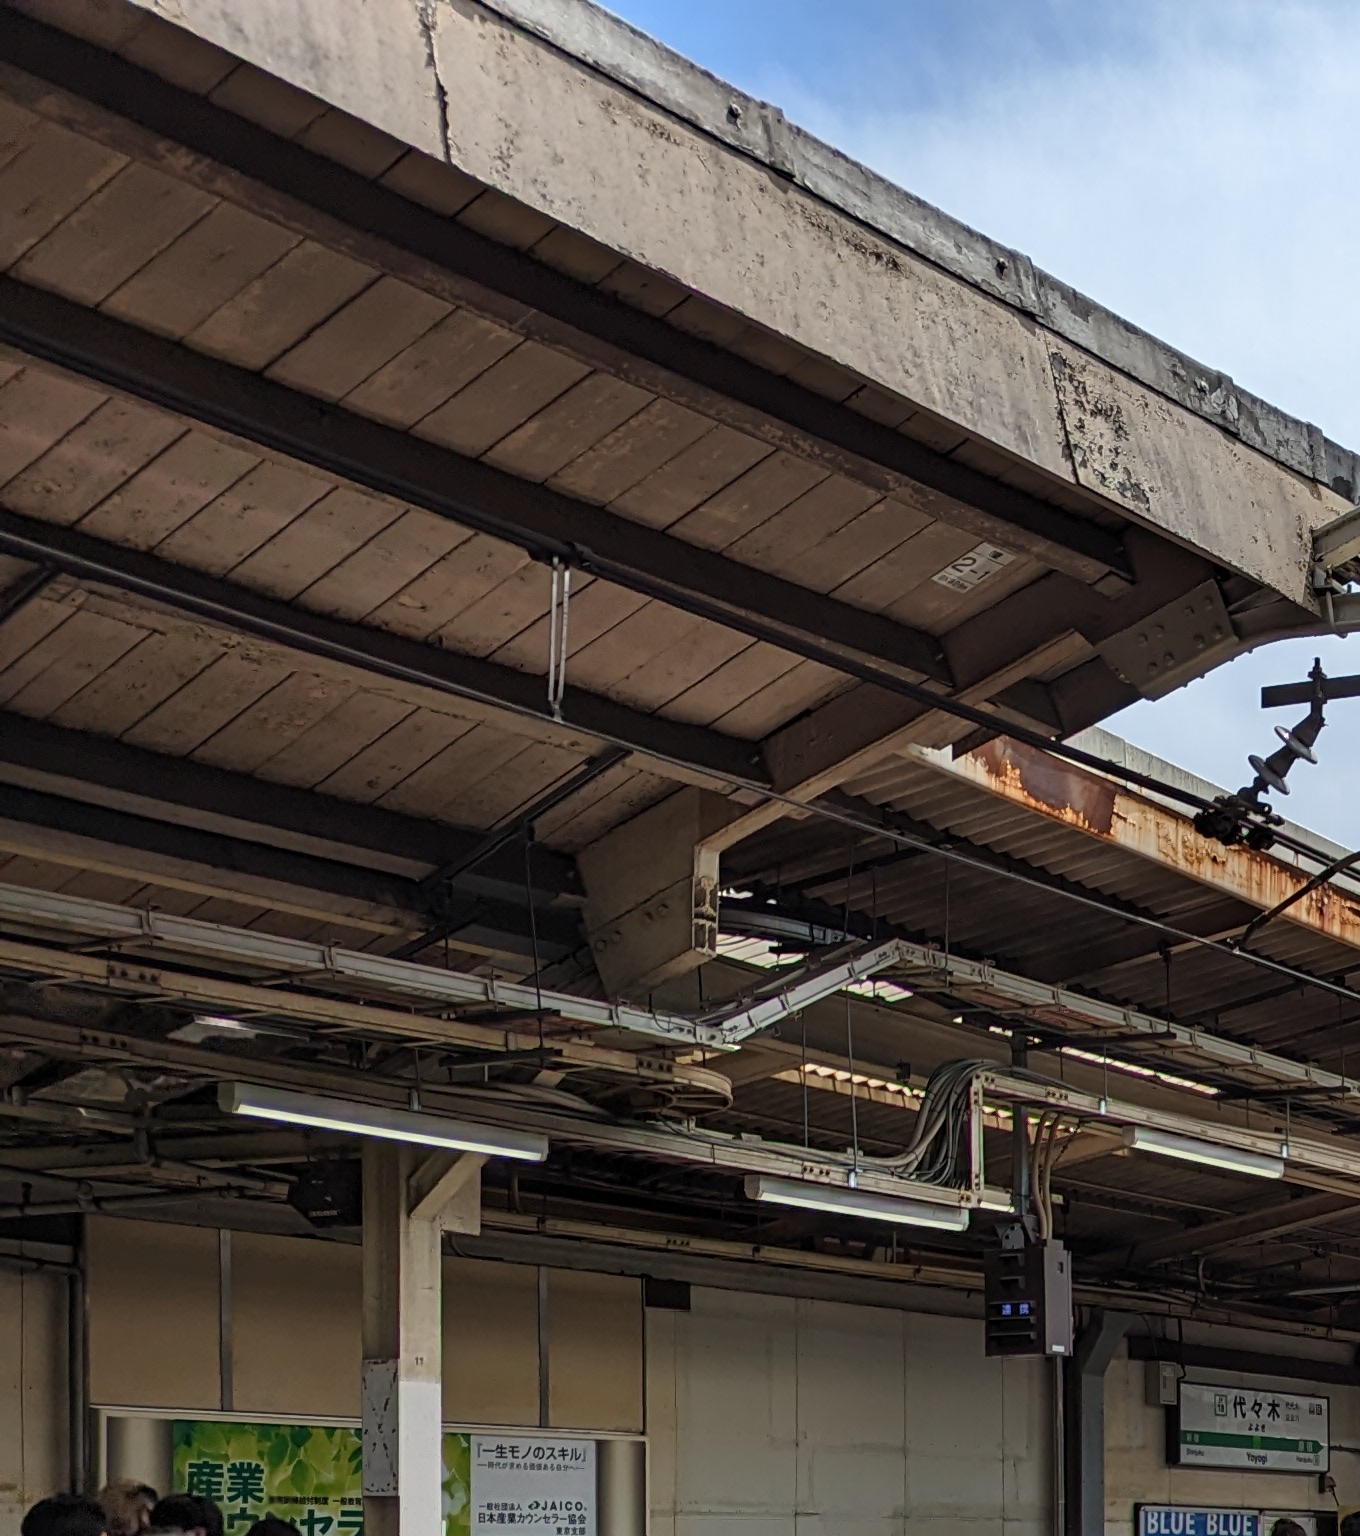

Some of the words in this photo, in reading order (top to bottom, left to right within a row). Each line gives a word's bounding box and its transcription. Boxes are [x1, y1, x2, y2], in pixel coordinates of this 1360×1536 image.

[951, 556, 990, 581] 2-1
[1233, 1395, 1281, 1422] 代々木
[1247, 1423, 1266, 1433] よよぎ
[477, 1442, 586, 1463] 『一生モノのスキル』
[1246, 1451, 1268, 1465] Yoyogi
[186, 1460, 265, 1504] 産業
[479, 1502, 522, 1512] 一般社団法人
[541, 1501, 583, 1512] JAICO
[478, 1512, 587, 1525] 日本産業カウンセラー協会
[1147, 1511, 1196, 1535] BLUE
[1206, 1513, 1253, 1536] BLUE
[556, 1526, 586, 1536] 東京支部
